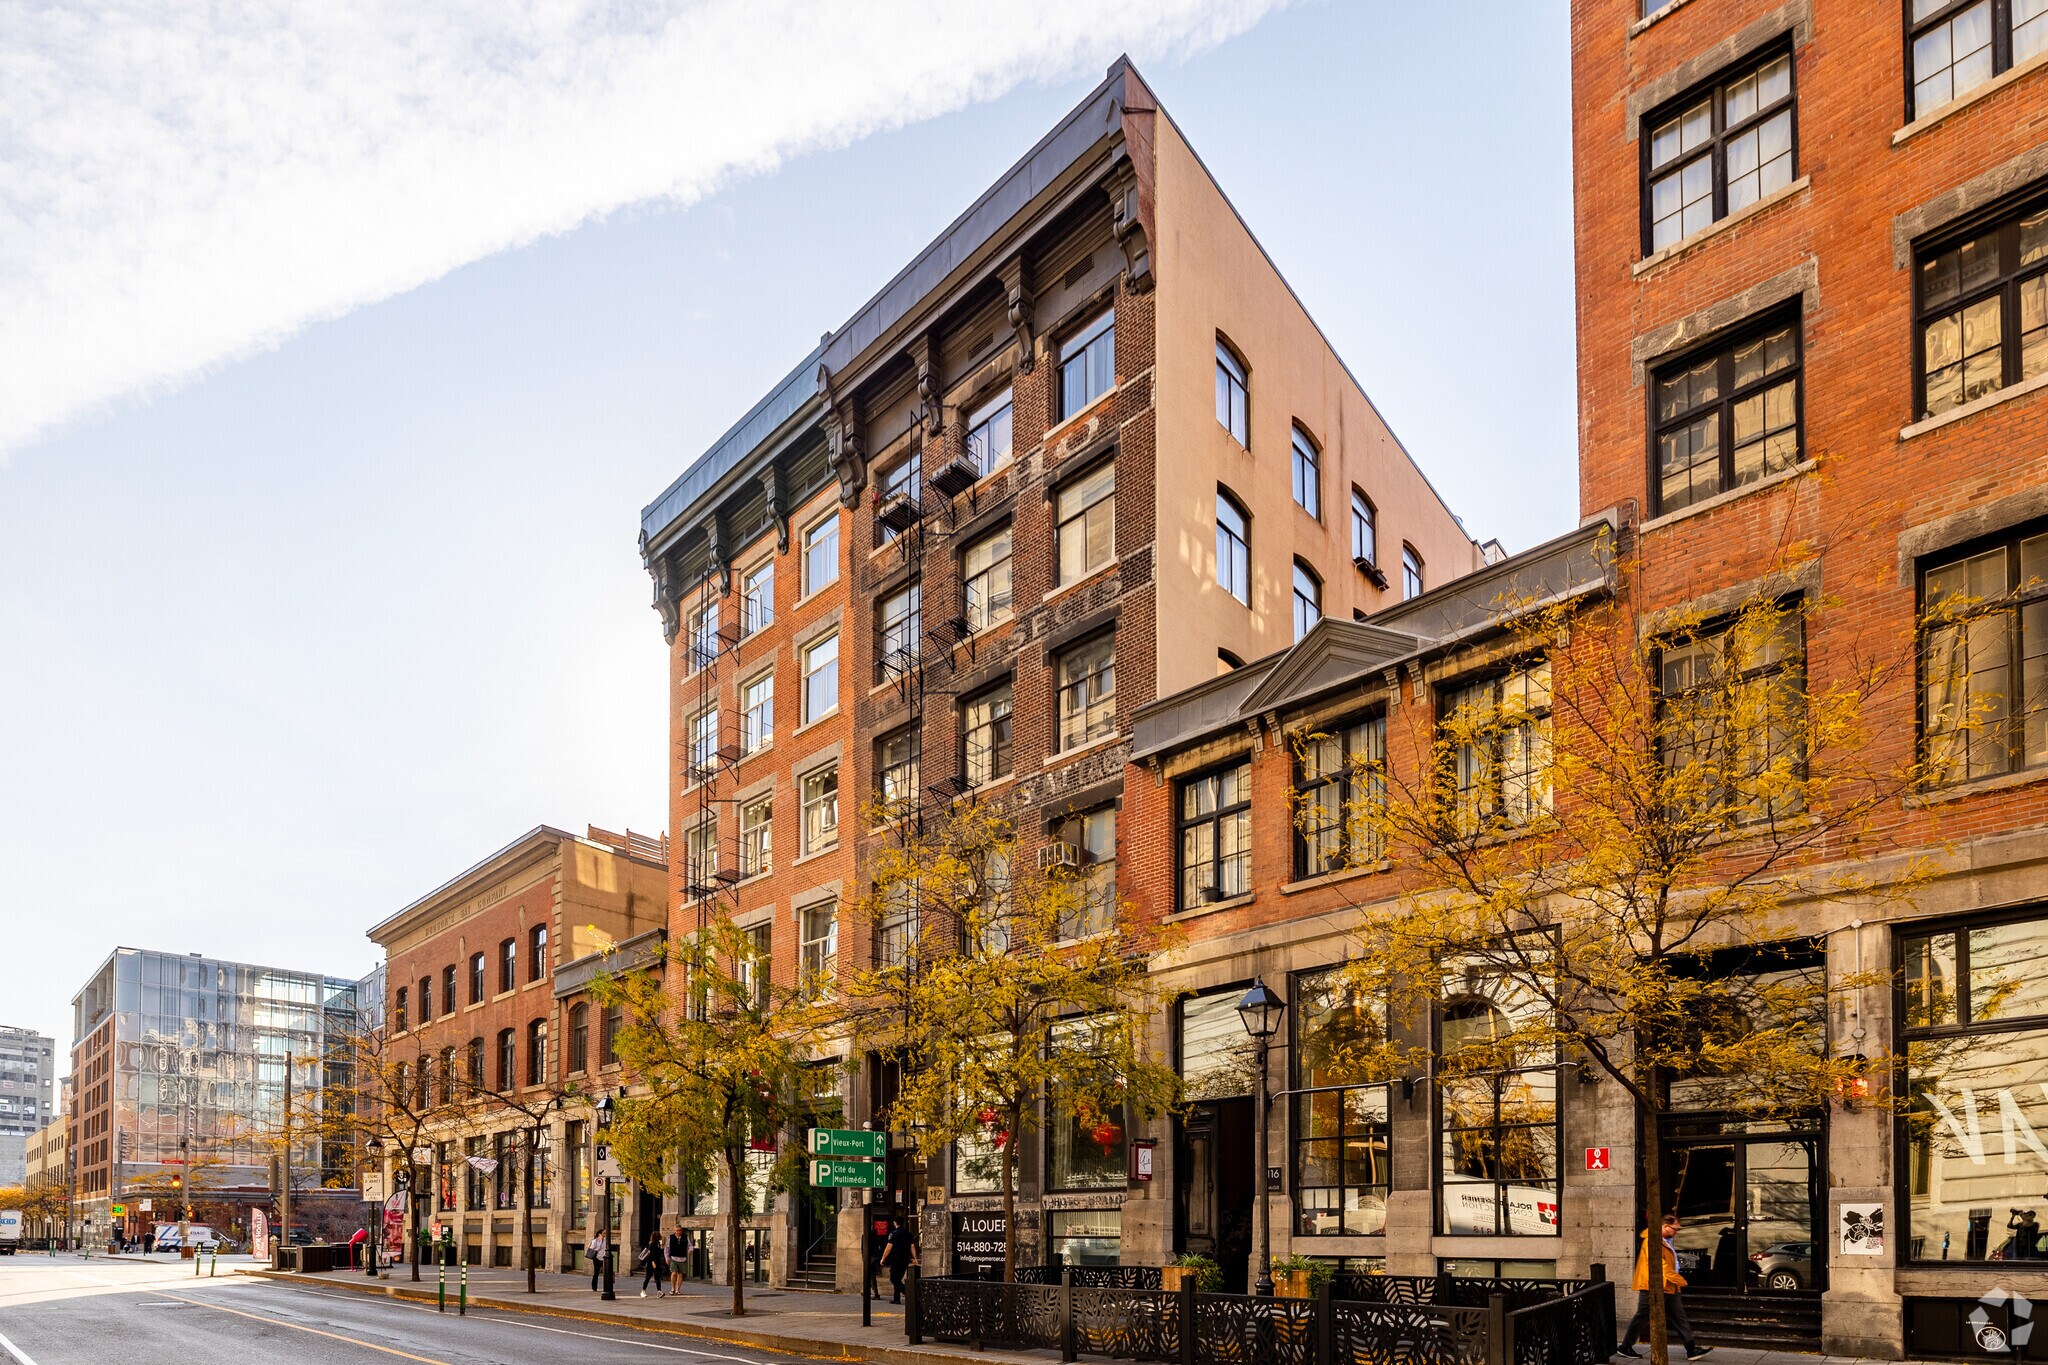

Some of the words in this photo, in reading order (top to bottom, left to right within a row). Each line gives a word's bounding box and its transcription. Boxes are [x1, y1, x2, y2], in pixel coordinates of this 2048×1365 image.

[816, 1132, 830, 1151] P
[833, 1139, 865, 1148] Vieux-Port
[818, 1164, 831, 1183] P
[834, 1165, 846, 1173] Cité
[847, 1166, 856, 1174] du
[834, 1175, 867, 1184] Multimédia
[962, 1216, 970, 1232] À
[957, 1241, 1006, 1252] 514-880-725
